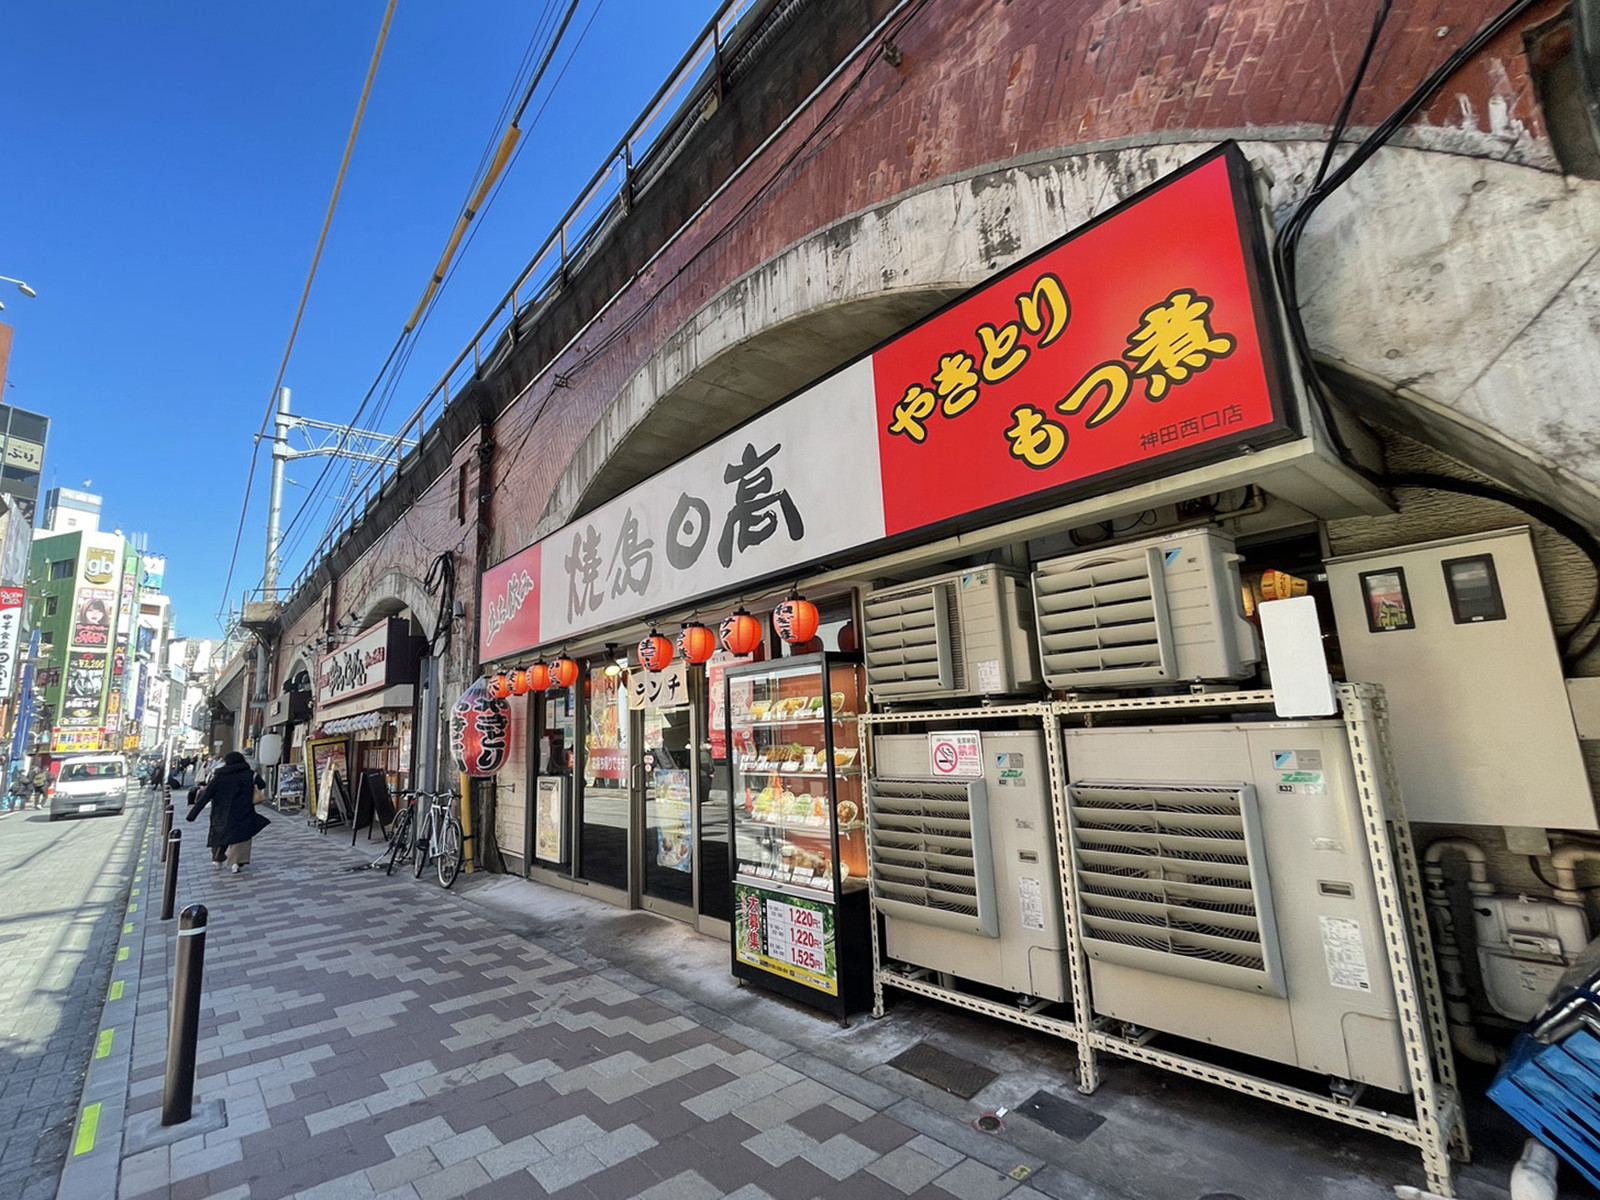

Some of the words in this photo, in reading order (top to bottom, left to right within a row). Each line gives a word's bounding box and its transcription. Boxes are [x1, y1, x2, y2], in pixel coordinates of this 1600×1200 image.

[889, 272, 1071, 443] やきとり
[1004, 288, 1236, 470] もつ煮
[1140, 404, 1243, 451] 神田西口店
[564, 442, 805, 625] 焼鳥日高
[635, 674, 681, 707] ランチ
[748, 893, 760, 951] 大募集
